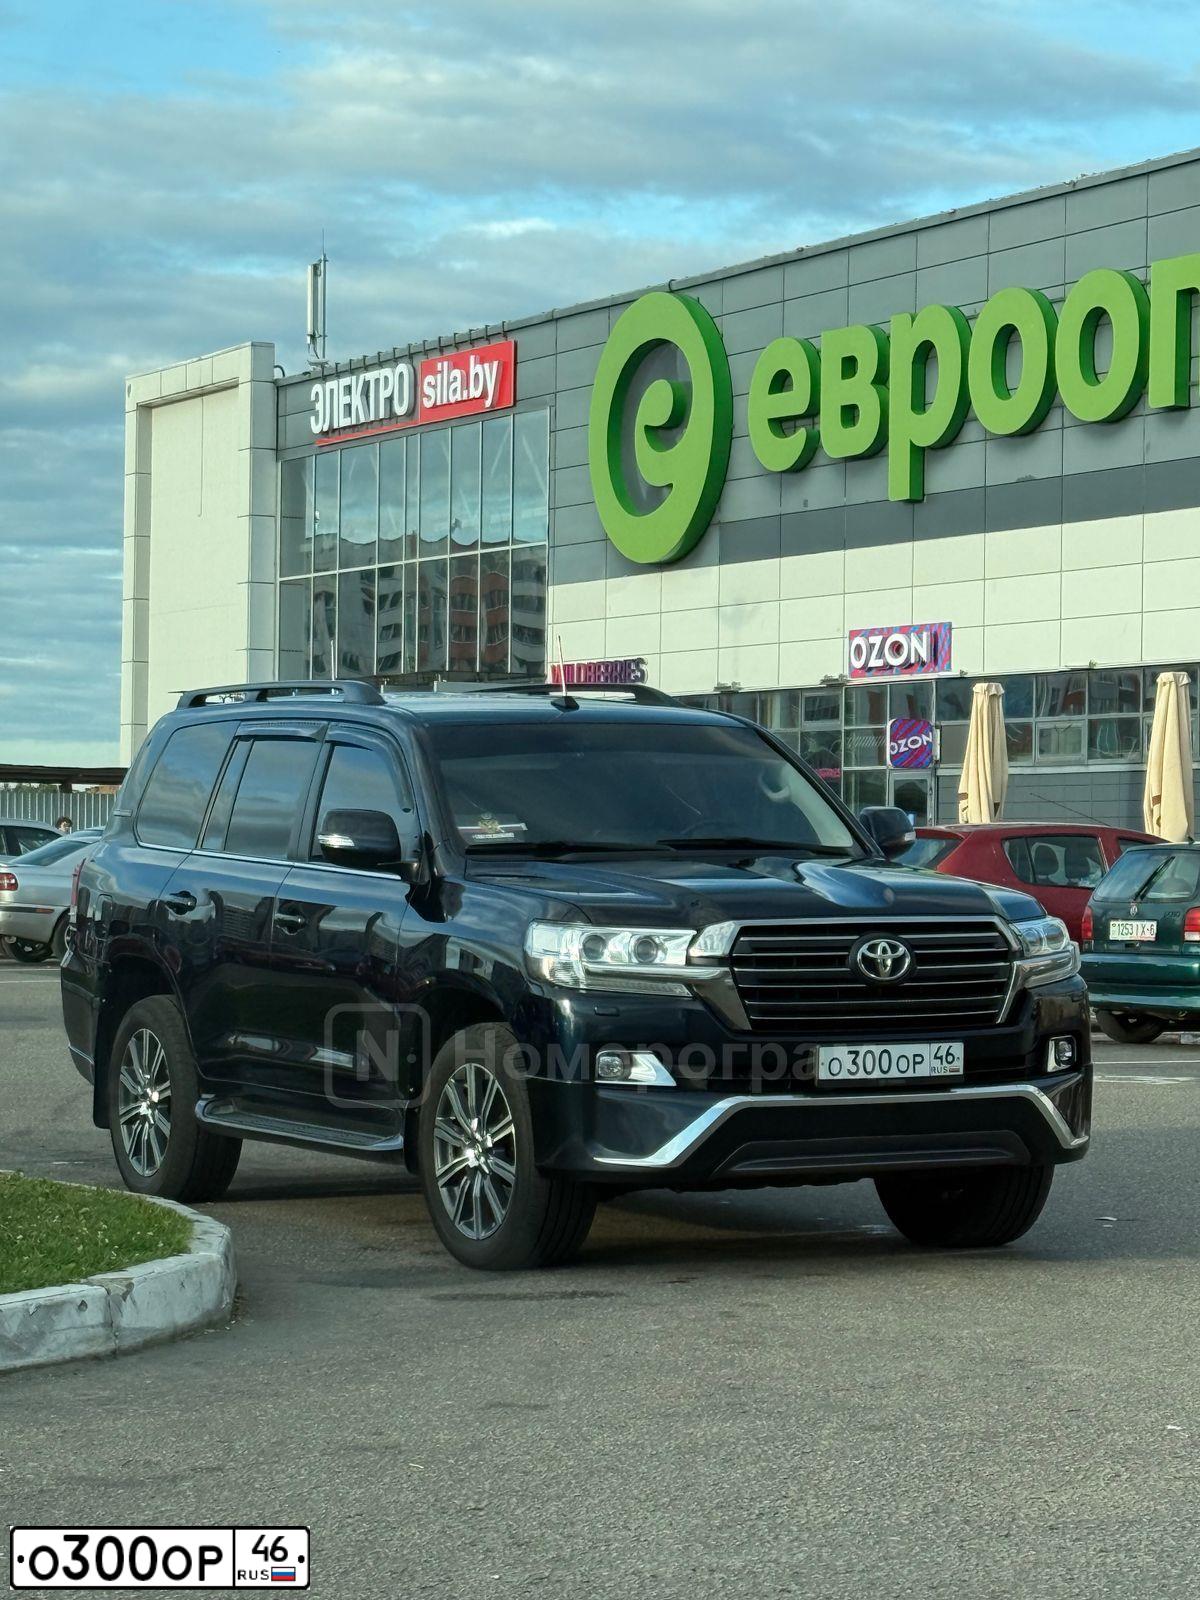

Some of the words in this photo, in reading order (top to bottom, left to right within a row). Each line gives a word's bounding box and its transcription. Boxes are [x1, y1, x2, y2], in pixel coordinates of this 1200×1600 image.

[423, 355, 500, 408] sila.by
[310, 363, 414, 434] ЭЛЕКТРО
[851, 631, 931, 669] OZON
[890, 732, 932, 755] OZON
[930, 1066, 948, 1074] RUS
[933, 1045, 956, 1066] 46
